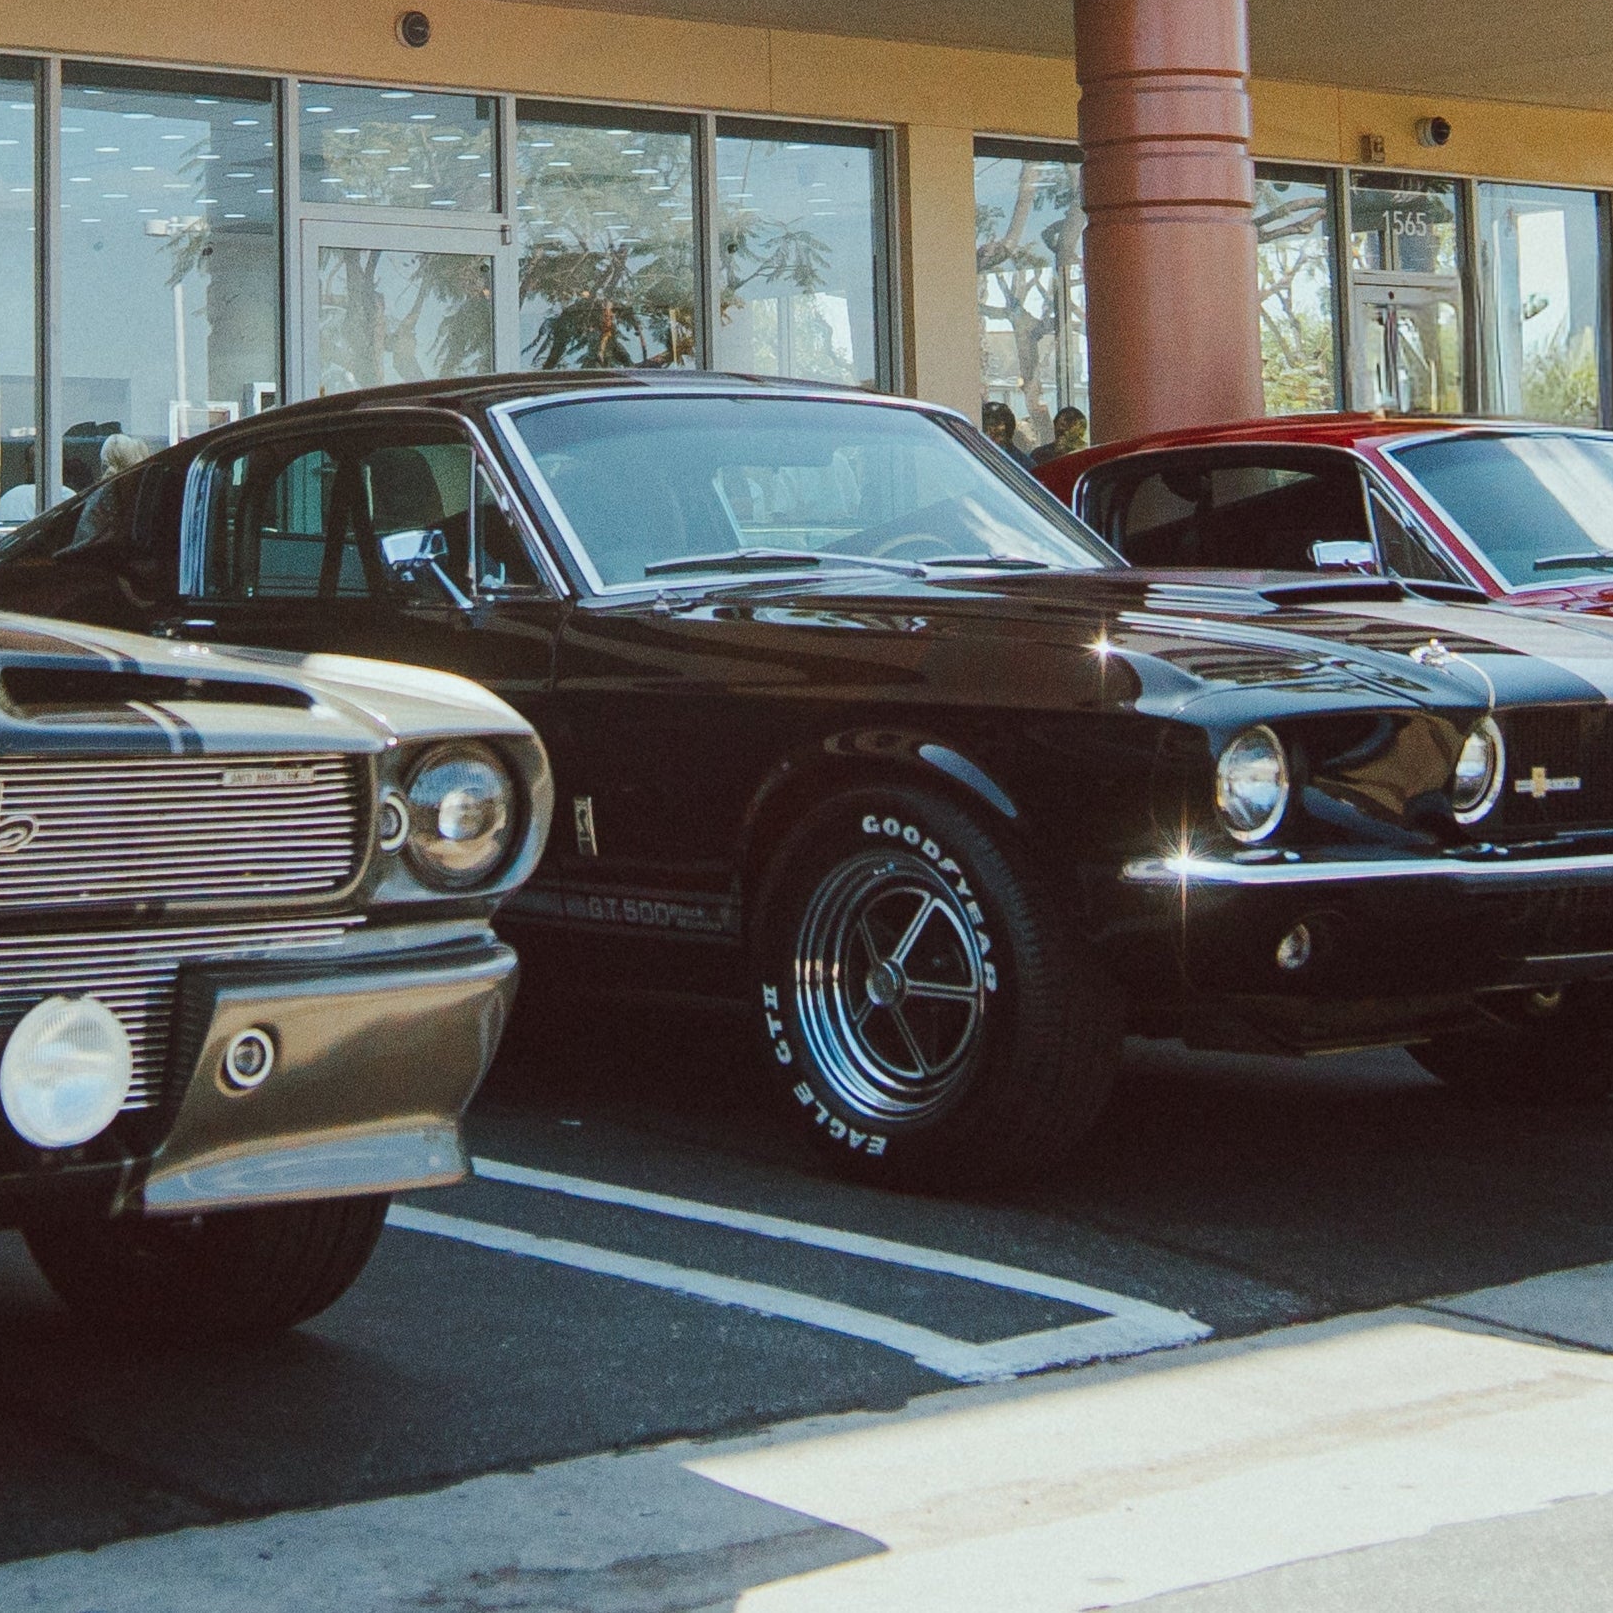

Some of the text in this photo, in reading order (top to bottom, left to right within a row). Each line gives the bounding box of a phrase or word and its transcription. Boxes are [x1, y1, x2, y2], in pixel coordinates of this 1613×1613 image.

[1382, 210, 1428, 237] 1565
[862, 815, 998, 992] GOODYEAR
[765, 1011, 793, 1065] GT
[793, 1081, 887, 1156] EAGLE
